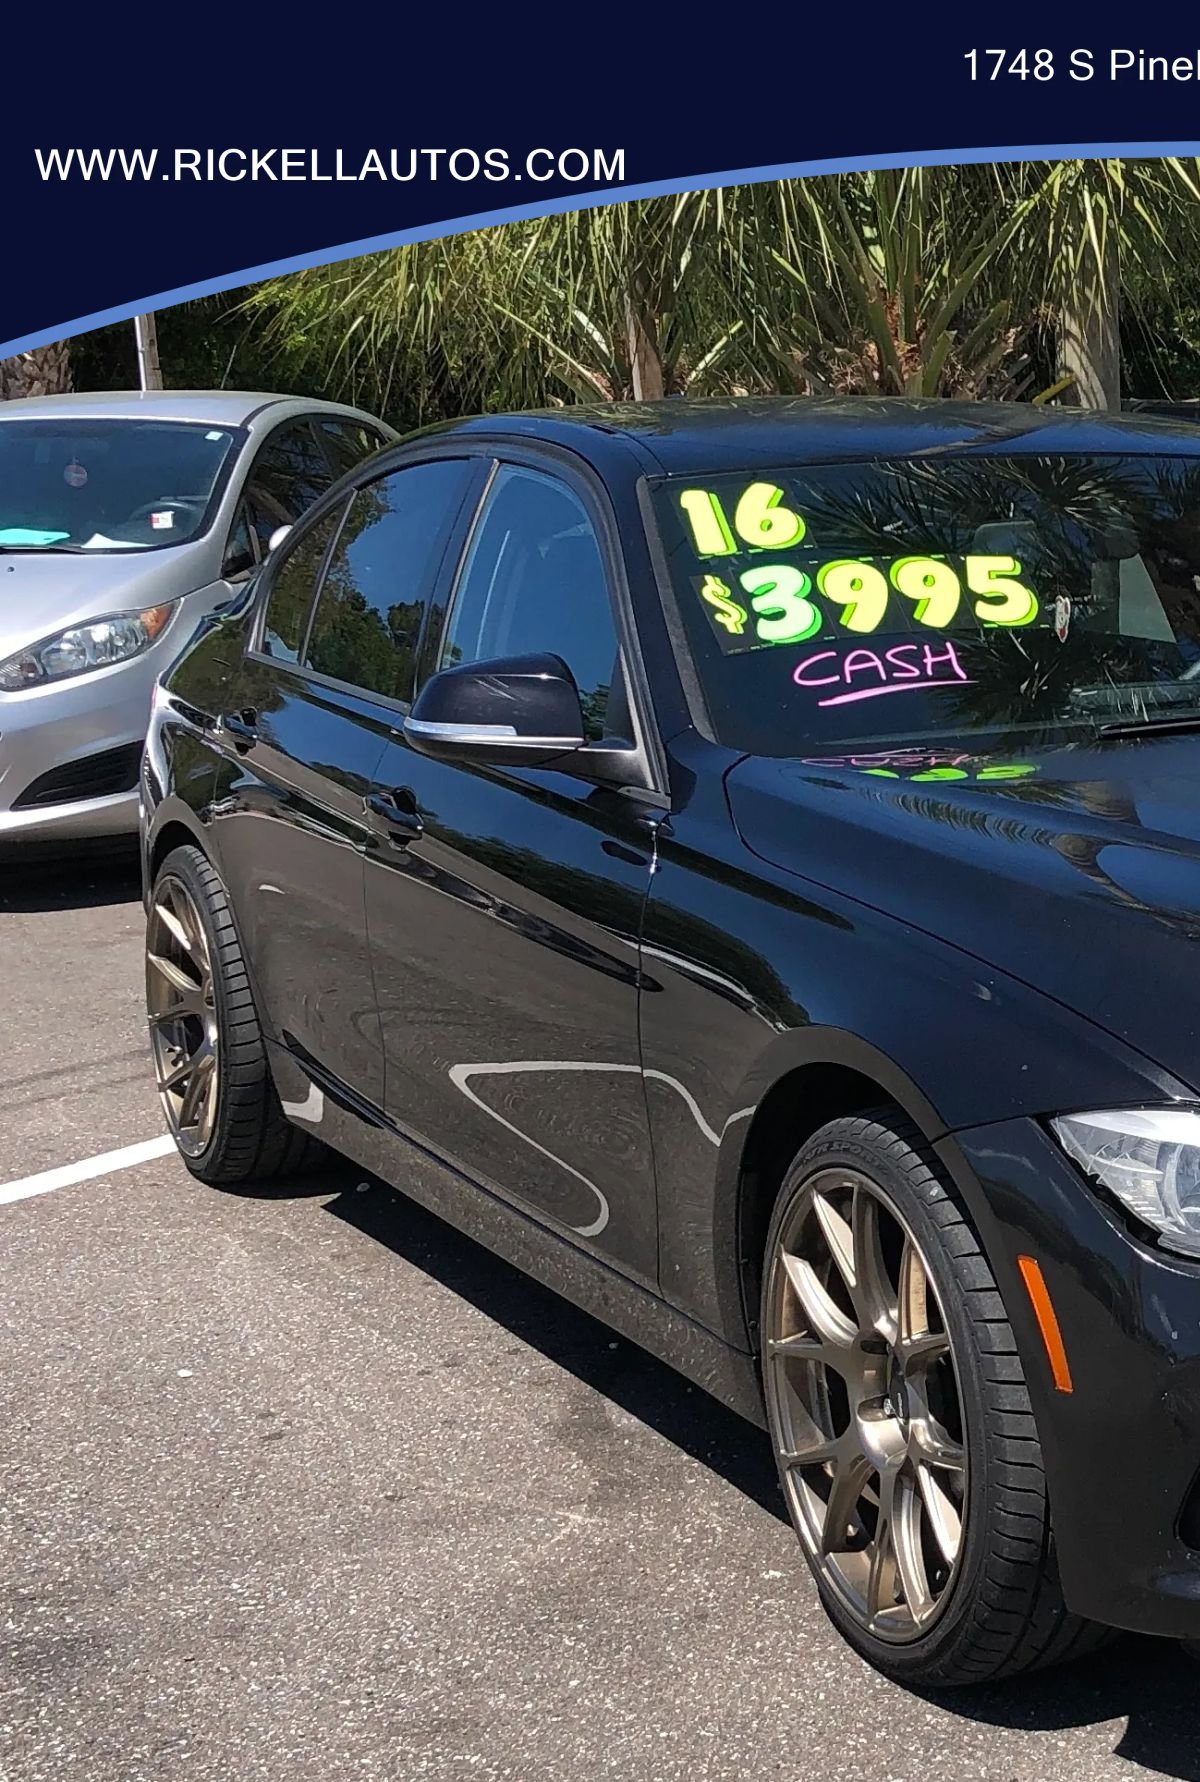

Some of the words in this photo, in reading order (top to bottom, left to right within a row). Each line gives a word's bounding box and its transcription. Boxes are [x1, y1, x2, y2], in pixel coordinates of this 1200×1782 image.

[680, 482, 807, 556] 16
[701, 555, 1040, 644] $3995
[793, 641, 968, 686] CASH
